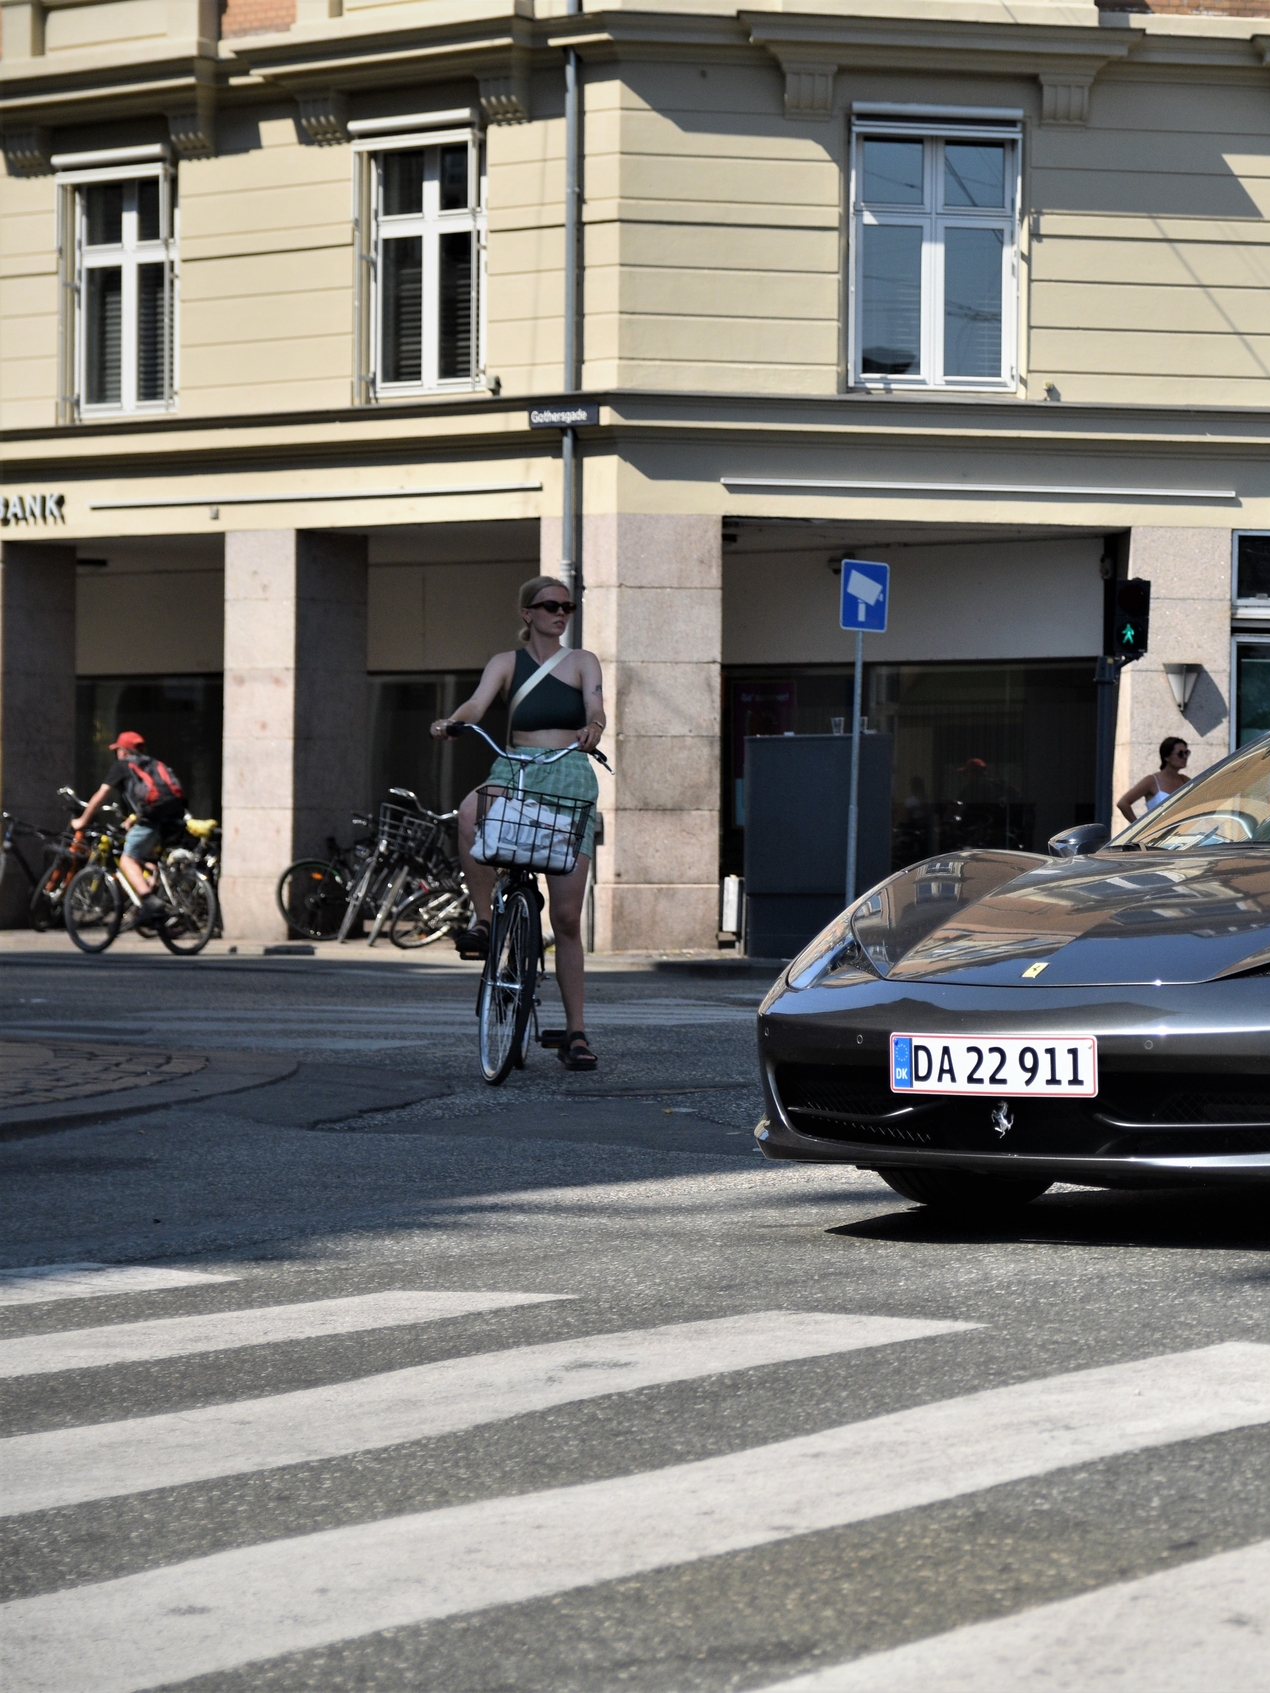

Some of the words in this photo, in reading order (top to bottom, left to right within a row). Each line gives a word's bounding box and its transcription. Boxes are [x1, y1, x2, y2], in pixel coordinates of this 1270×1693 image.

[896, 1068, 908, 1080] DK
[914, 1045, 957, 1083] DA
[966, 1046, 1008, 1085] 22
[1018, 1046, 1084, 1087] 911
